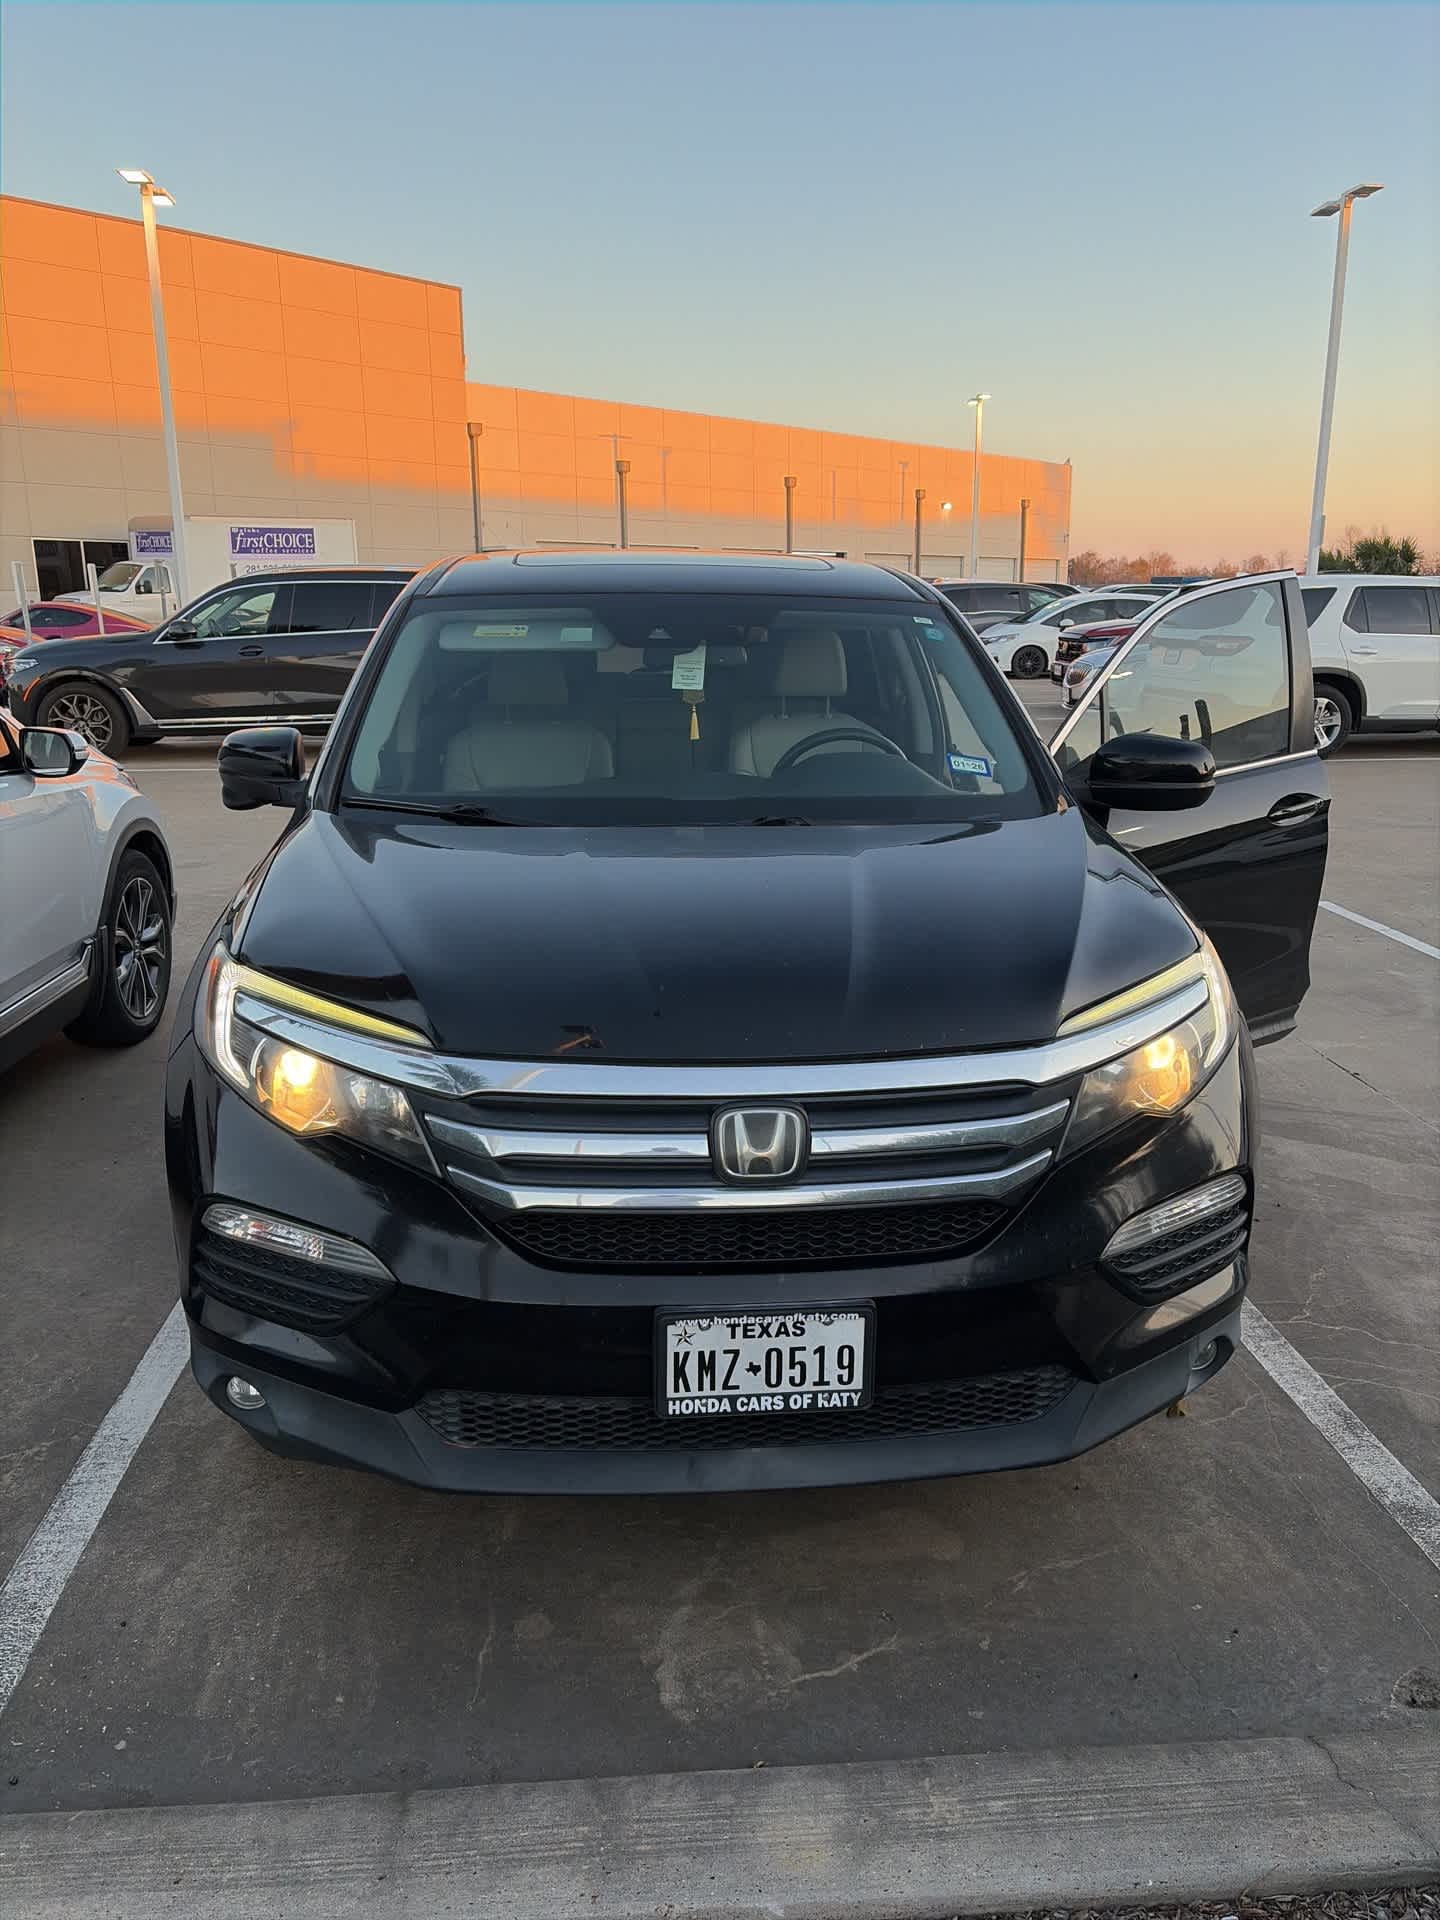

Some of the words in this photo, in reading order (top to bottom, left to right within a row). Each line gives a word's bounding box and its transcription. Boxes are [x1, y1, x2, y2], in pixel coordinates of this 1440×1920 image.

[675, 1312, 859, 1328] www.hondacarsofkaty.com
[726, 1321, 806, 1340] TEXAS
[668, 1398, 731, 1415] HONDA
[736, 1394, 785, 1413] CARS
[789, 1393, 813, 1410] OF
